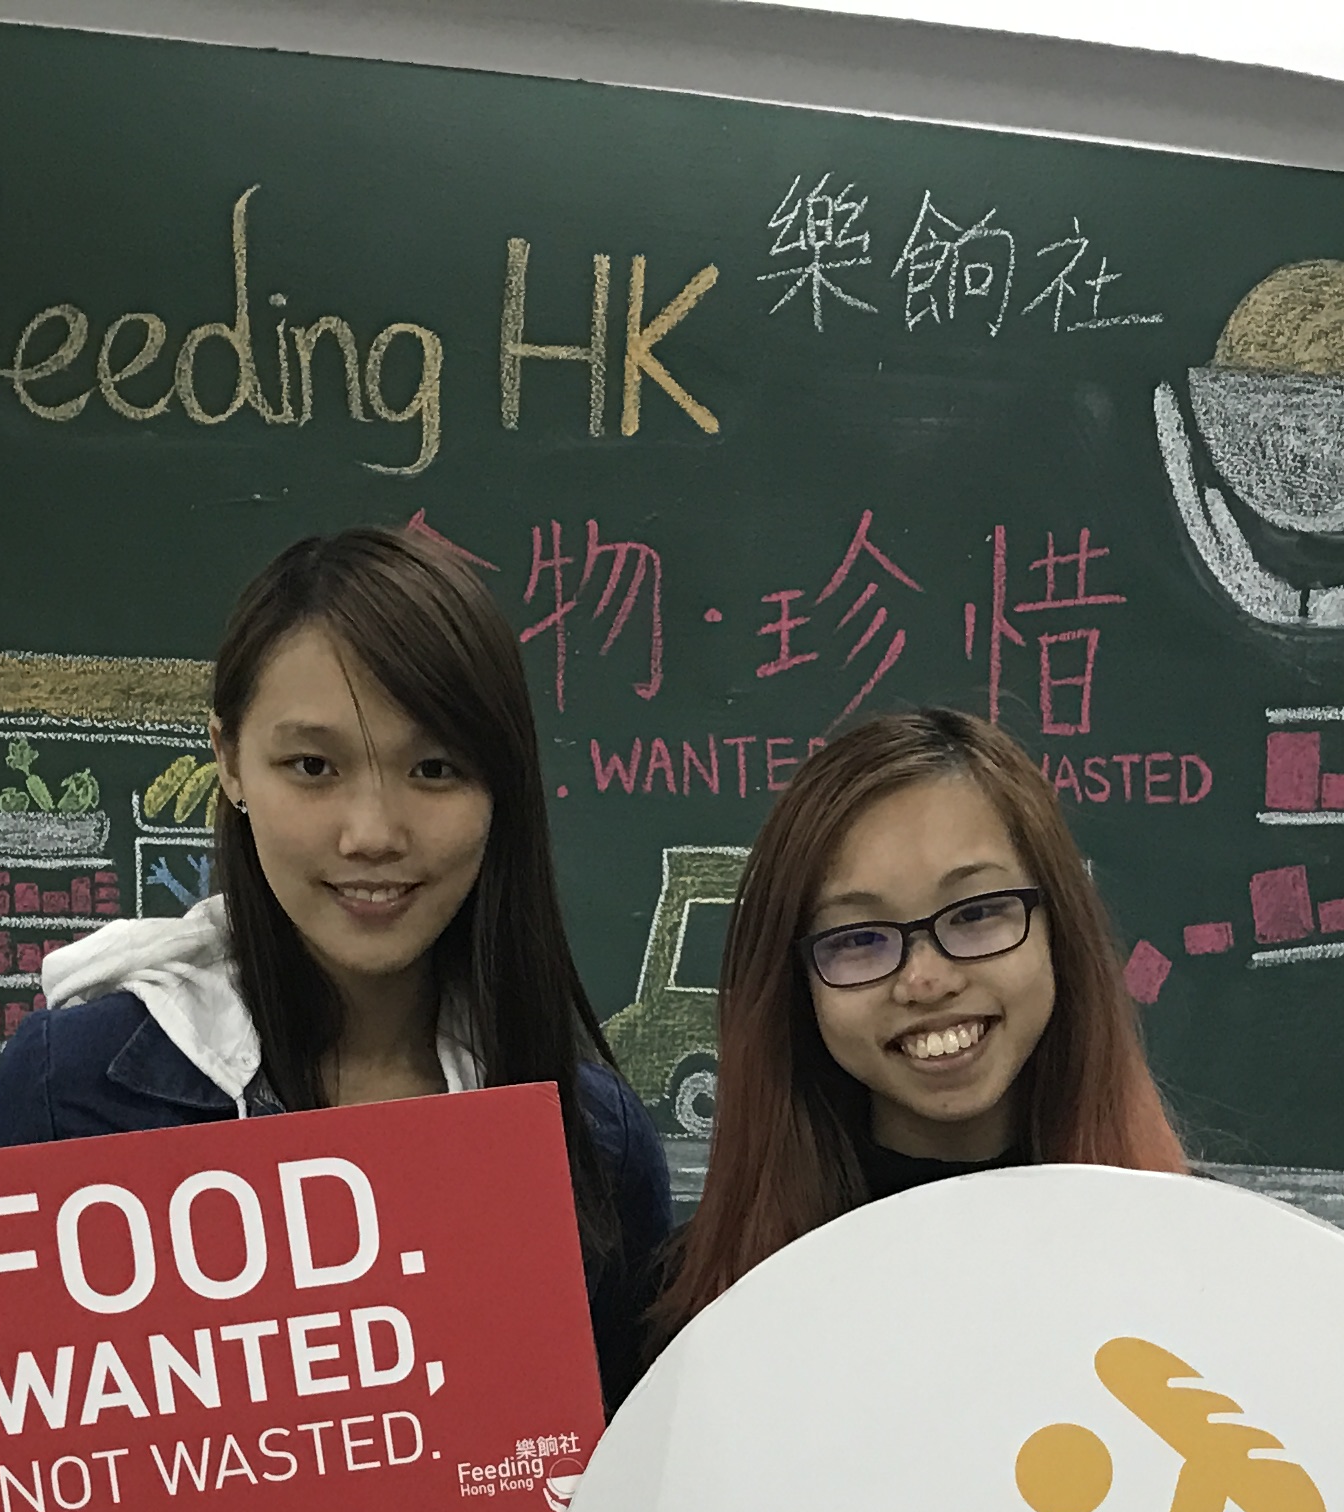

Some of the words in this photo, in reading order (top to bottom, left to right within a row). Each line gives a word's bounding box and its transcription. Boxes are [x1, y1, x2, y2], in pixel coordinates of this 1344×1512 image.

[499, 236, 721, 438] HK
[590, 735, 828, 799] WANTE
[150, 1410, 442, 1496] WASTED.
[457, 1457, 545, 1484] Feeding
[460, 1484, 495, 1497] Hong
[500, 1478, 534, 1491] Kong
